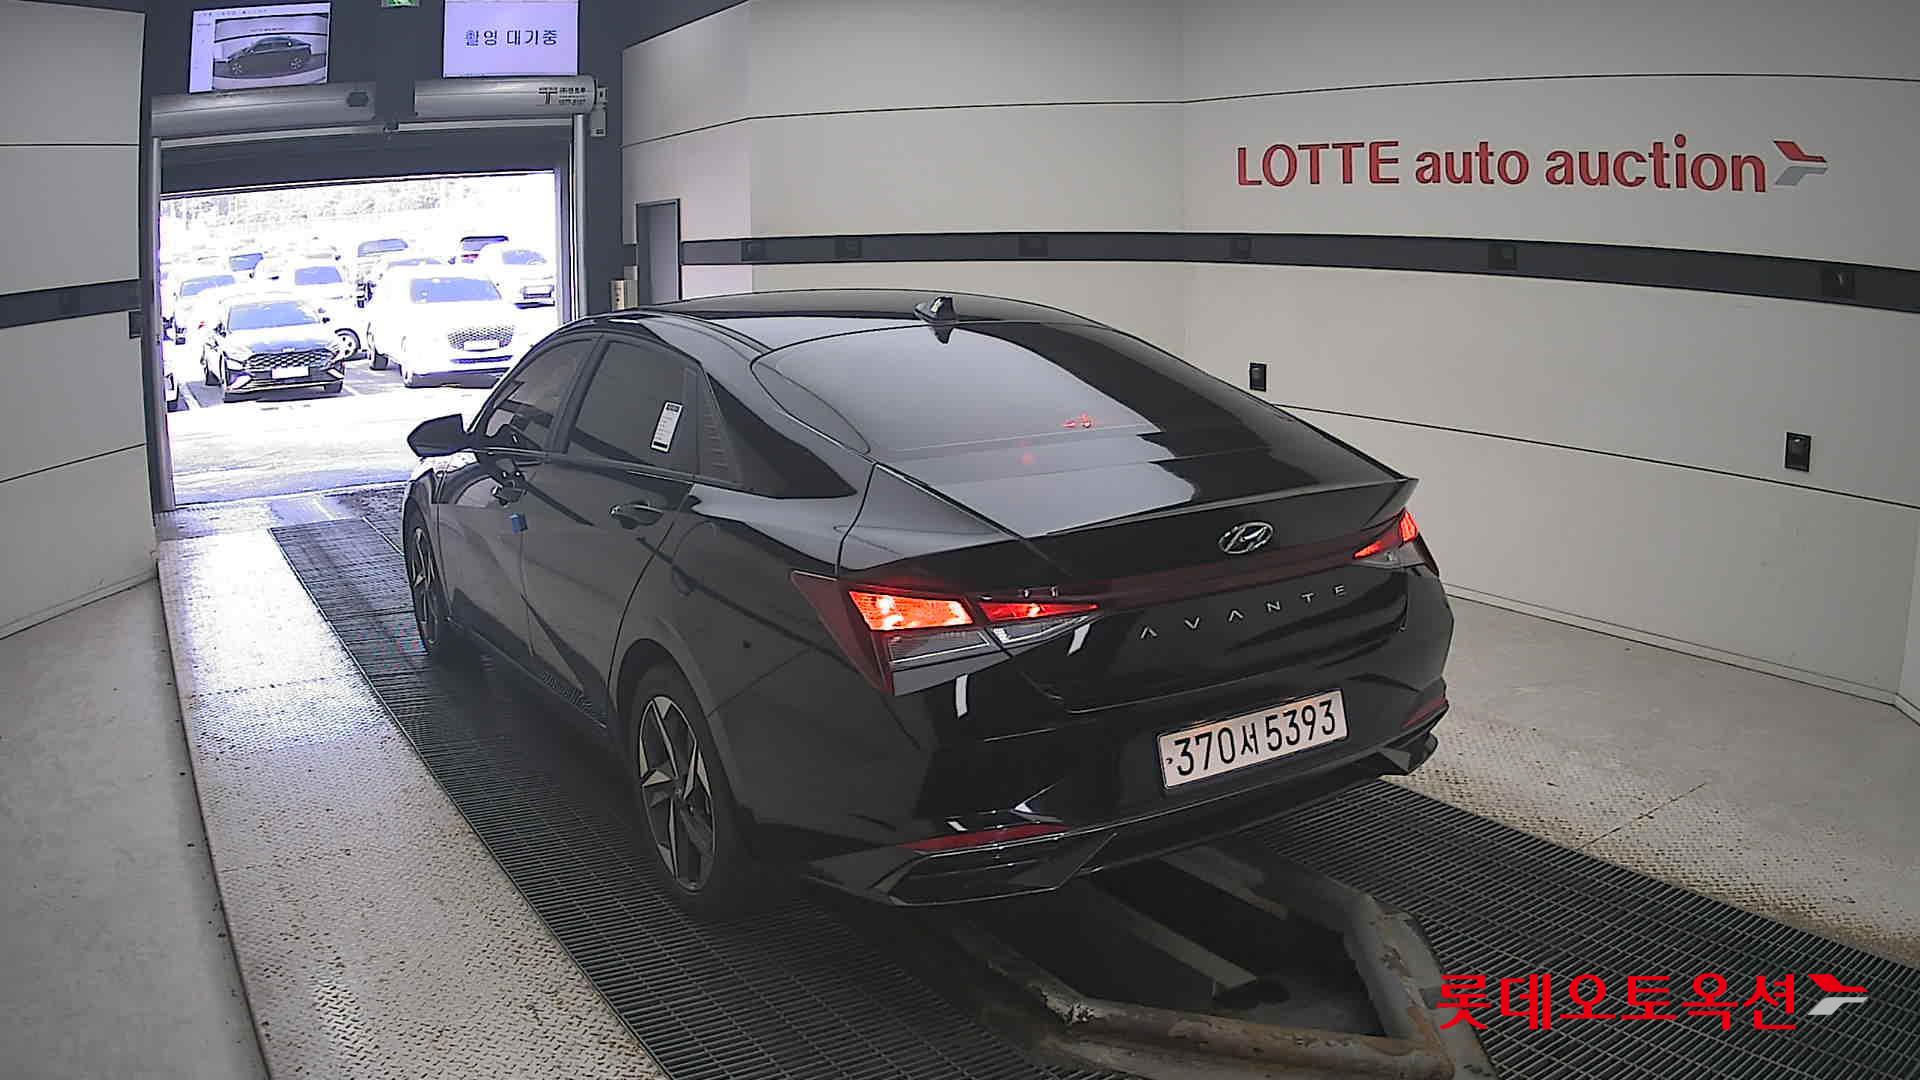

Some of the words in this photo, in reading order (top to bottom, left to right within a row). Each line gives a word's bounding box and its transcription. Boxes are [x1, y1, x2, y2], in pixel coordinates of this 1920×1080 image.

[506, 29, 559, 46] 대기중
[1237, 140, 1400, 187] LOTTE
[1415, 141, 1529, 185] auto
[1545, 133, 1767, 193] auction
[1140, 584, 1345, 639] AVANTE
